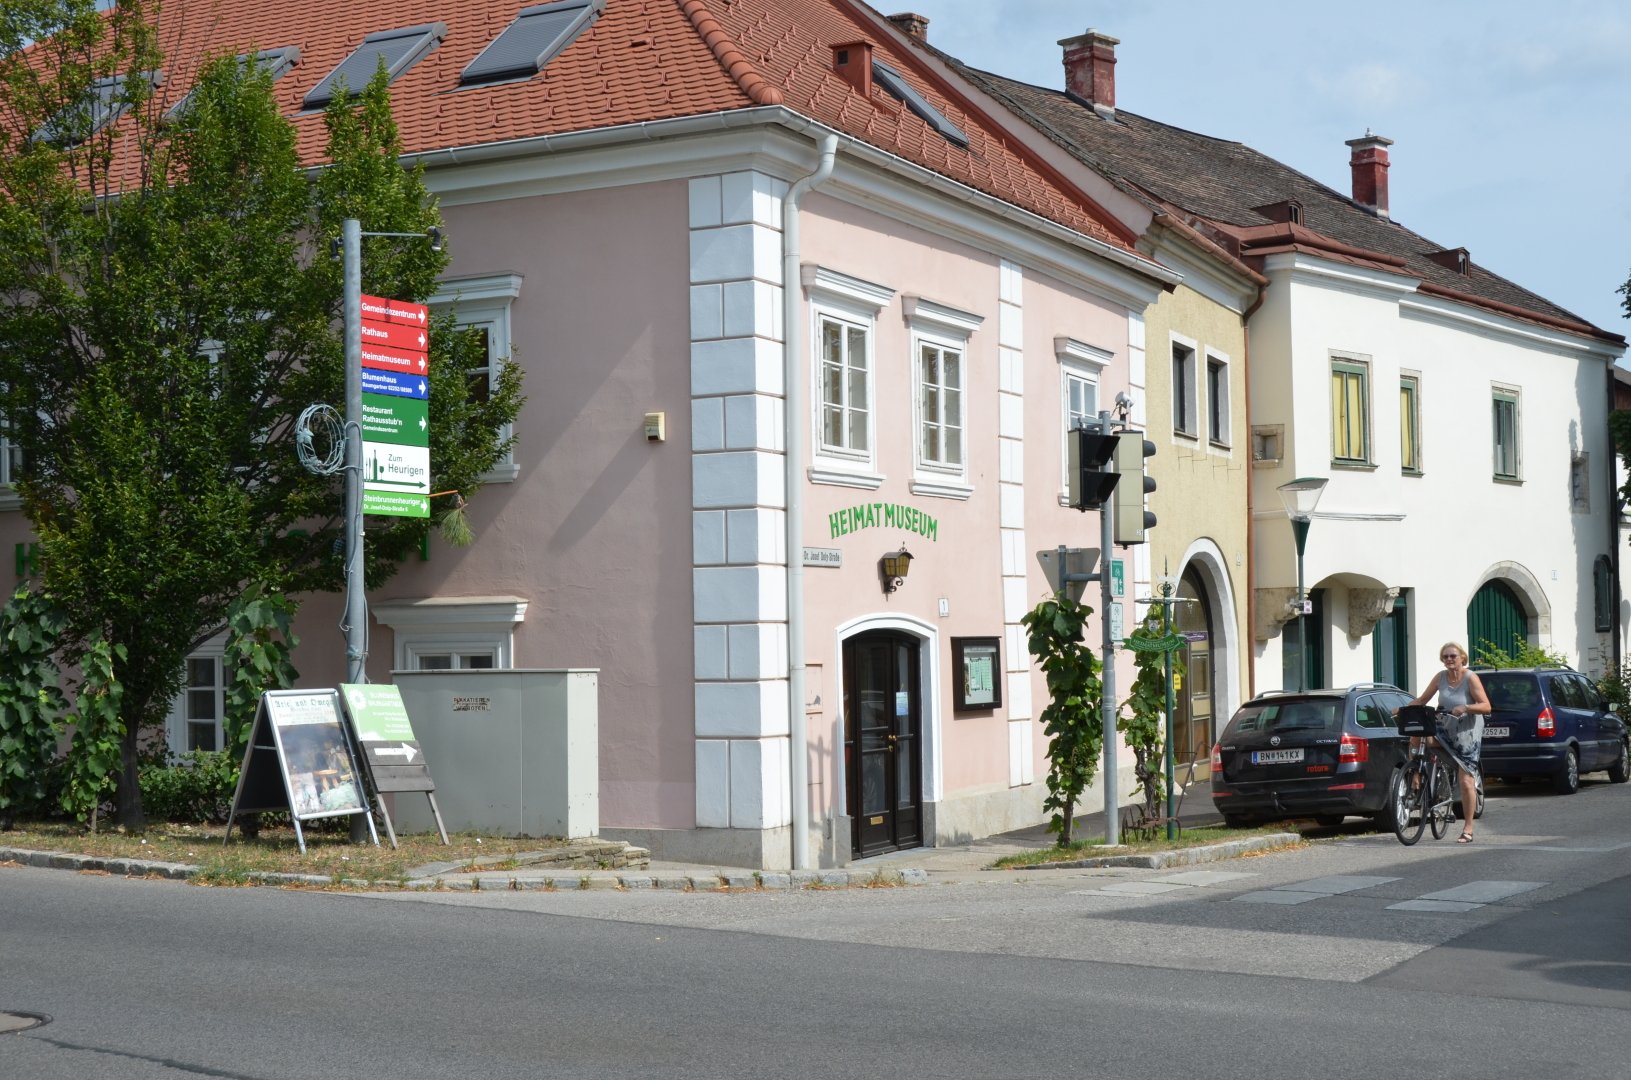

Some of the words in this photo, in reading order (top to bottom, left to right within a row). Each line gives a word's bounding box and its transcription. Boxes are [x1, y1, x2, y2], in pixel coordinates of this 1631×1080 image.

[361, 326, 389, 339] Rathaus
[361, 351, 411, 366] Heimatmuseum
[361, 372, 397, 384] Blumenhaus
[362, 404, 393, 416] Restaurant
[388, 453, 403, 462] Zum
[388, 463, 424, 477] Heurigen
